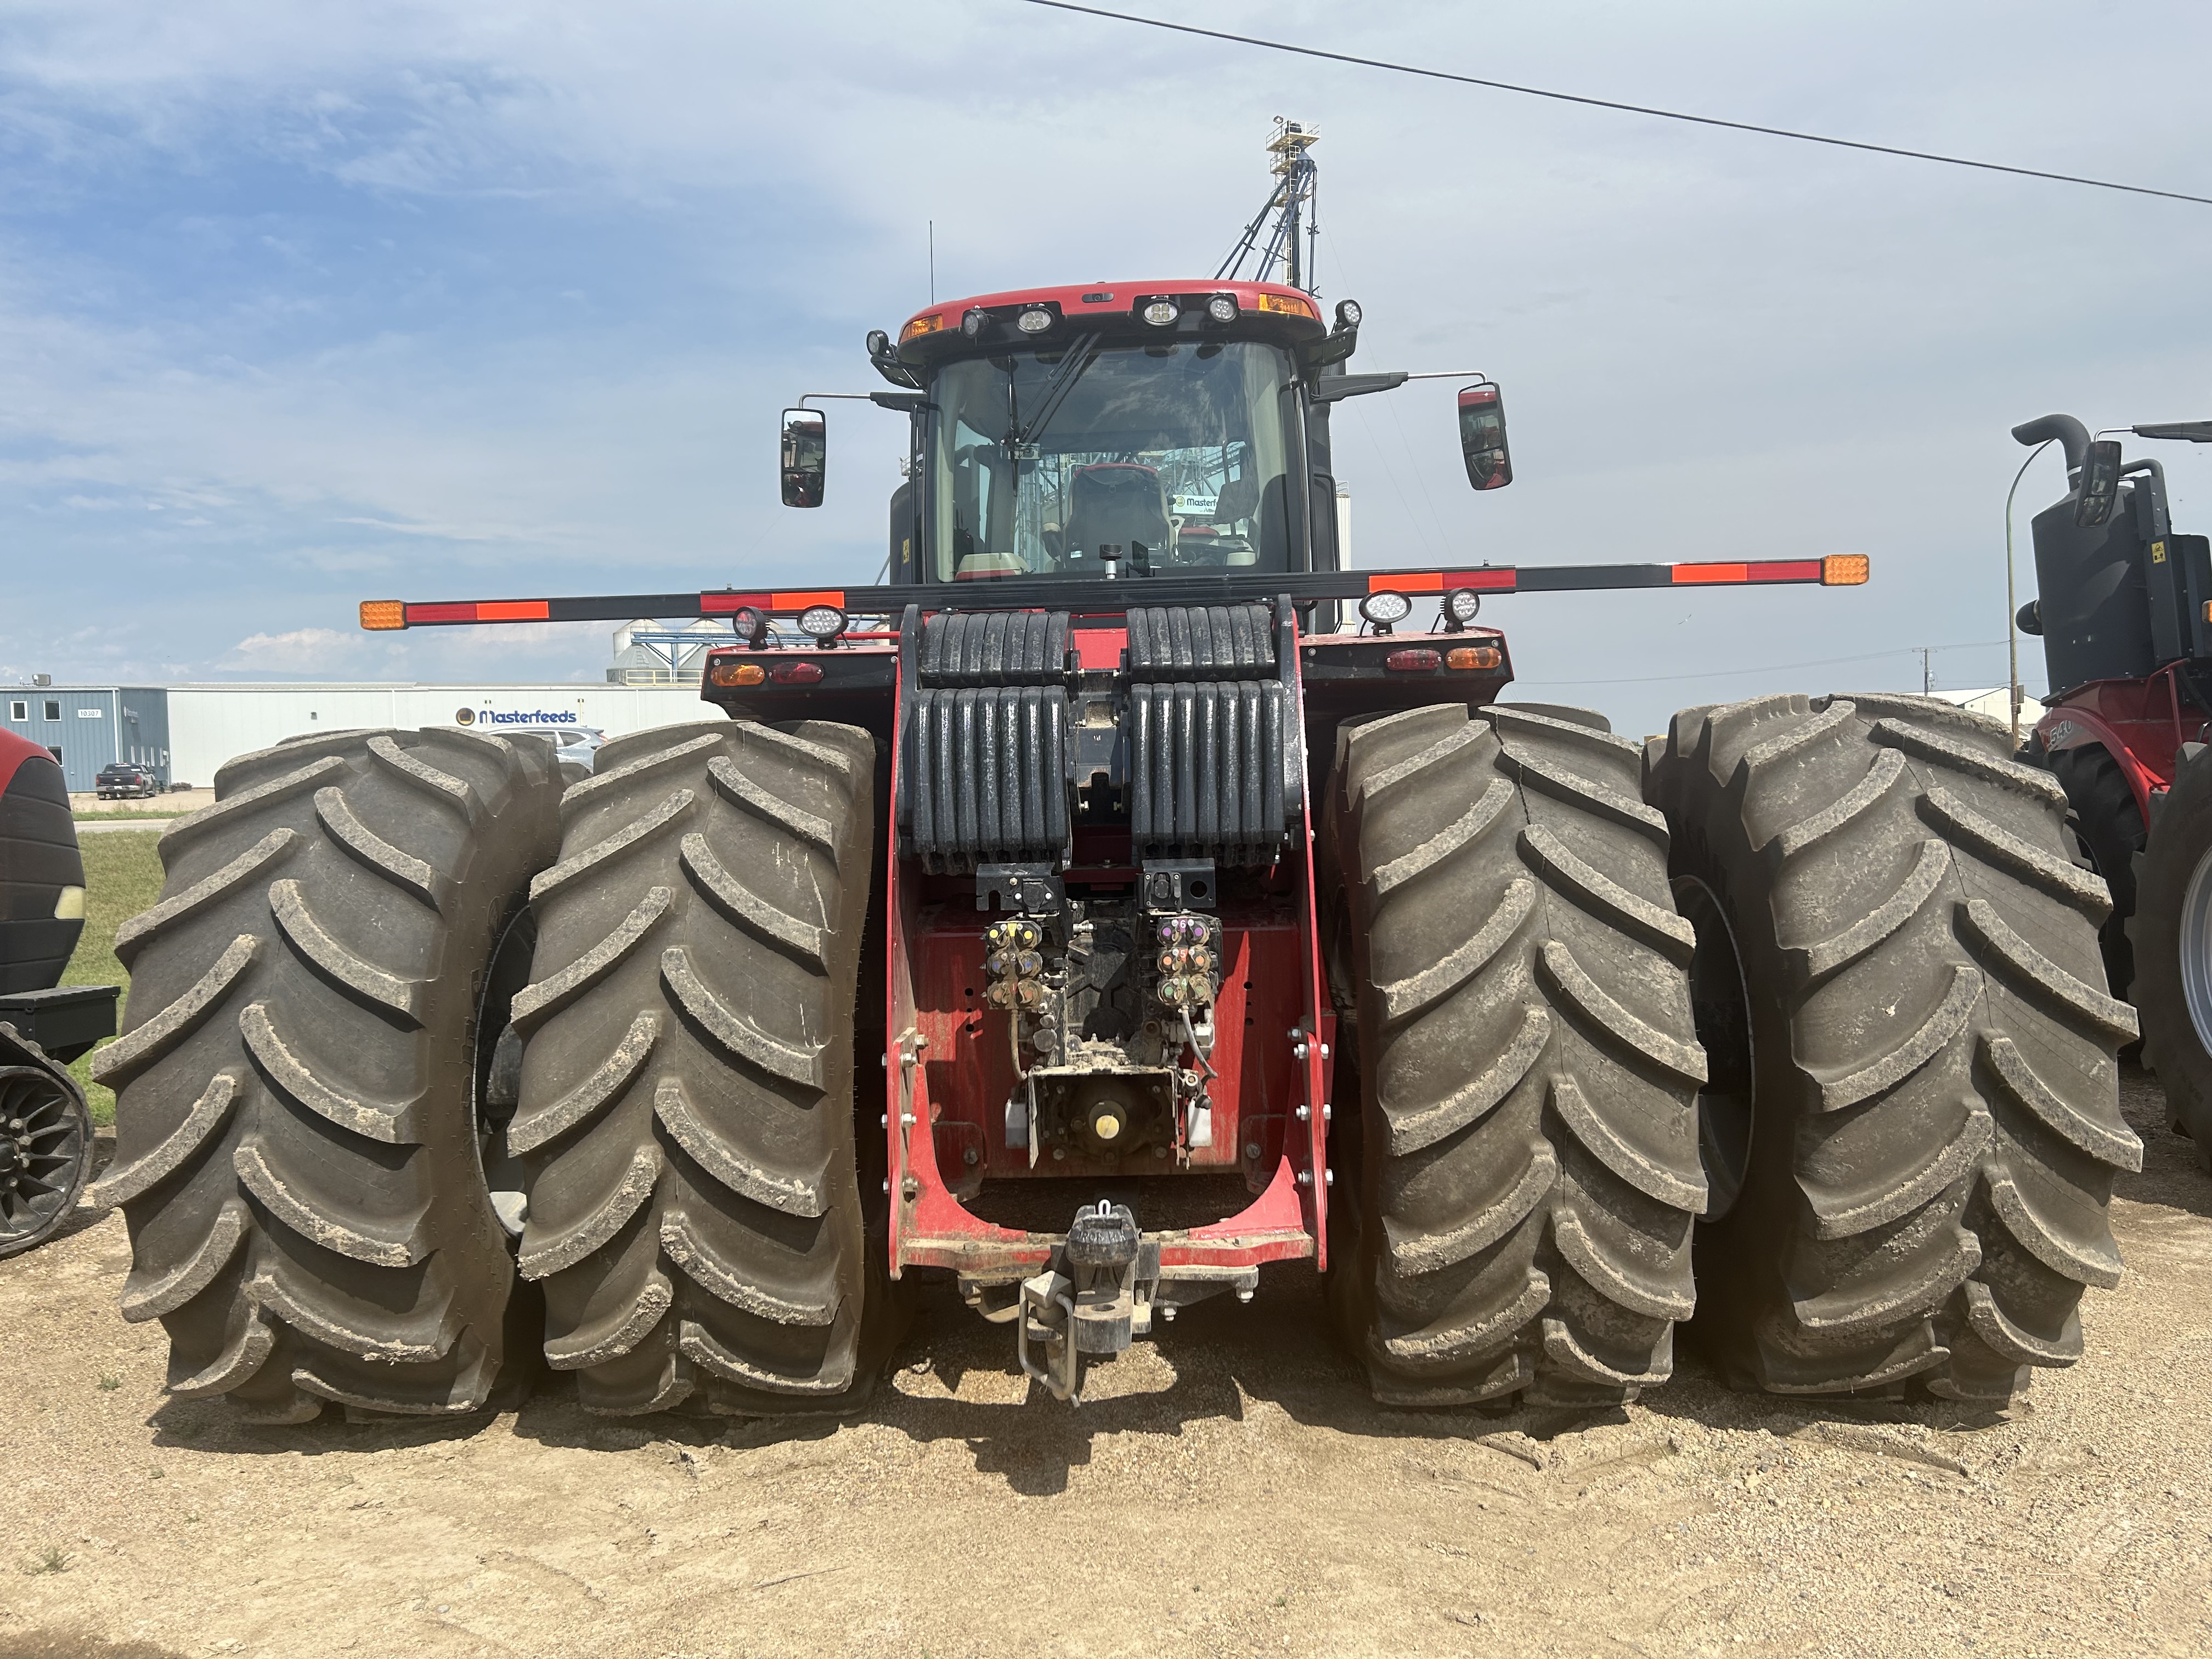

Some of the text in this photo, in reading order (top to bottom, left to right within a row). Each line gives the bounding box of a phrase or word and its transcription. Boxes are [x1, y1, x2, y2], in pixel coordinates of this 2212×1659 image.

[479, 709, 577, 723] Masterfeeds
[2050, 720, 2074, 746] 540
[1180, 920, 1186, 928] 6
[1180, 950, 1186, 958] 5
[1181, 978, 1187, 986] 4
